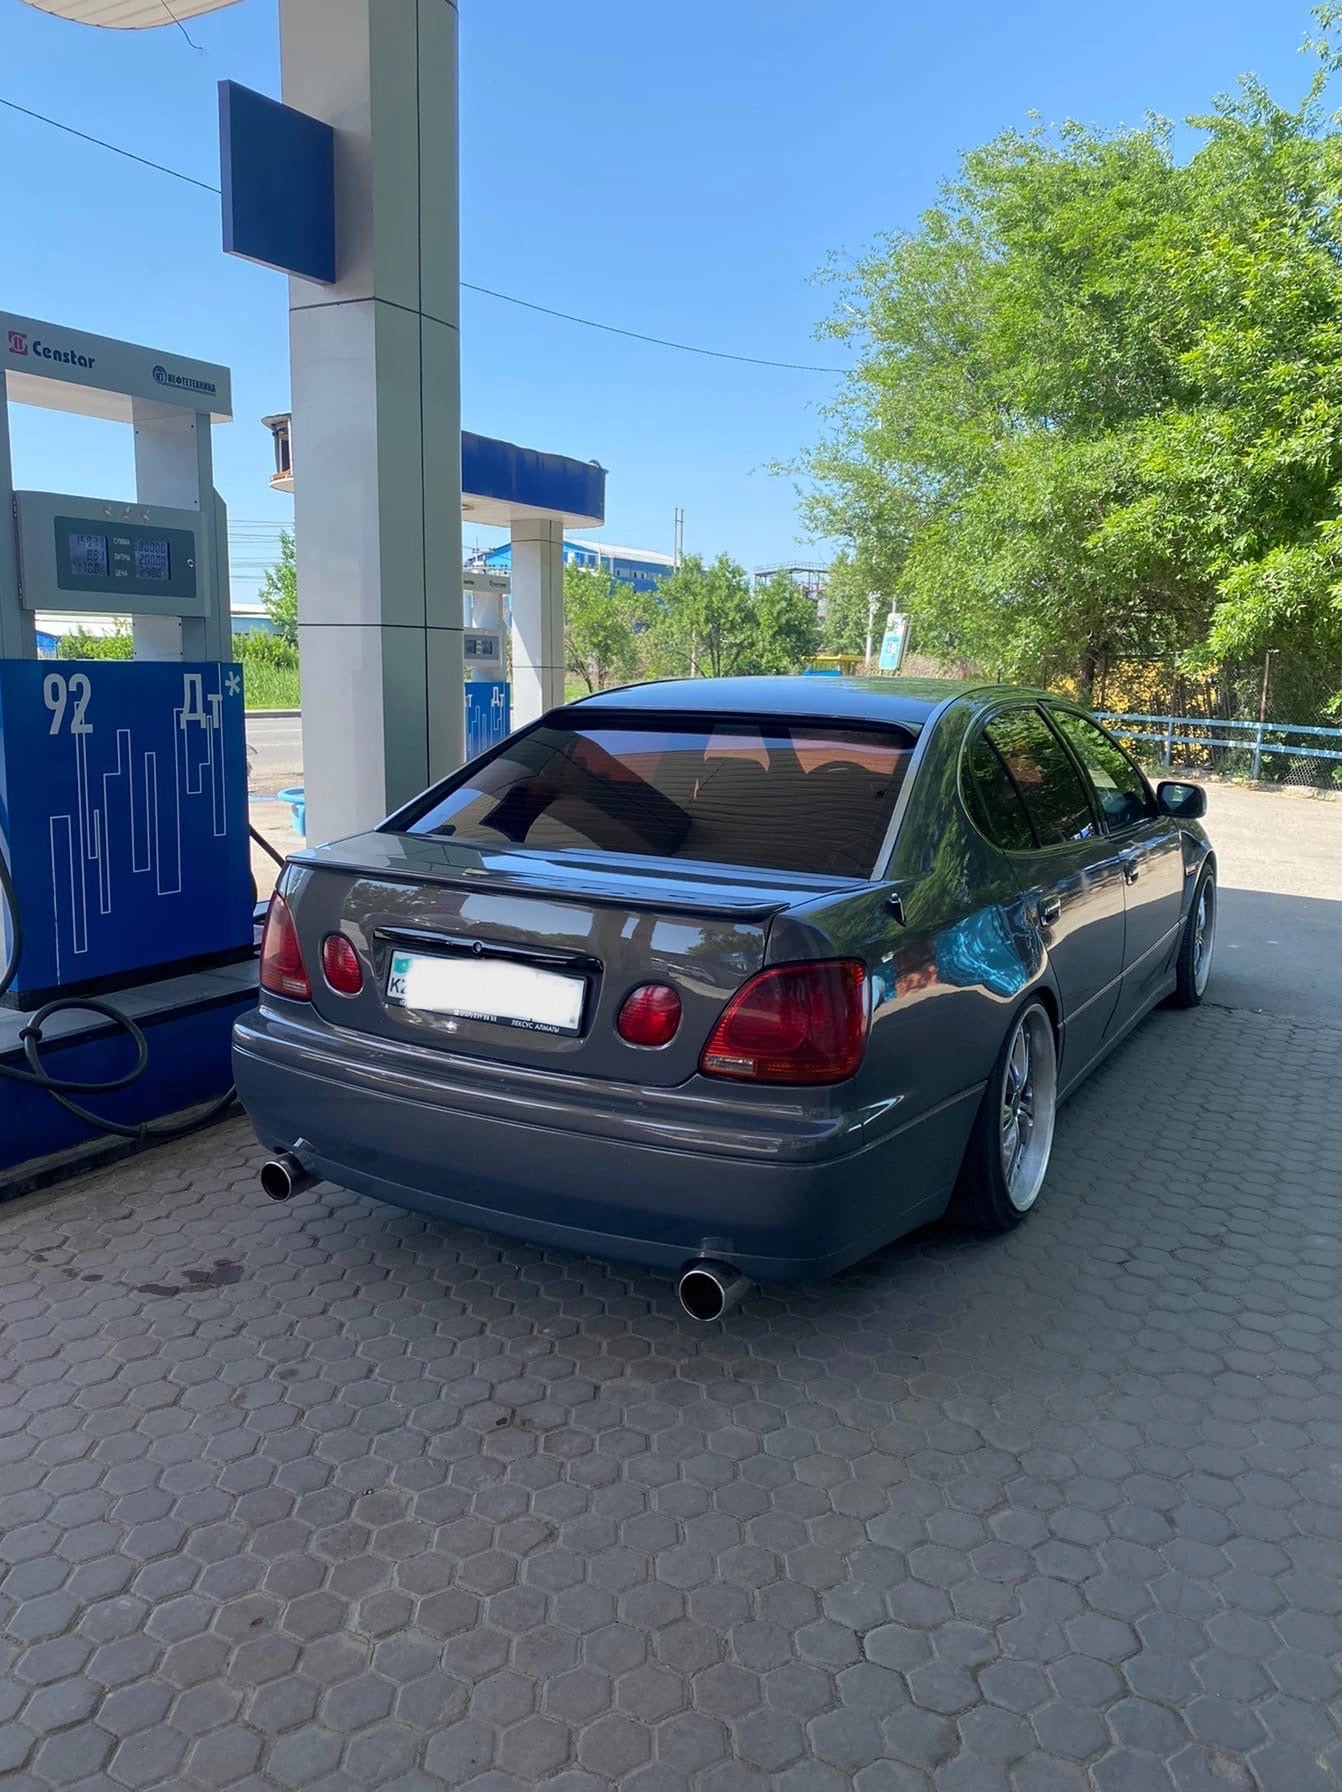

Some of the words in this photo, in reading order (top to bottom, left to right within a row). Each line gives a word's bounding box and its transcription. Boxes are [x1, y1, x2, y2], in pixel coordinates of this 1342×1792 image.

[32, 340, 96, 369] Censtar
[167, 373, 217, 393] НЕФТЕТЕХНИКА
[115, 569, 128, 577] ЦЕНА
[43, 673, 93, 735] 92
[510, 1019, 534, 1029] ЛЕКСУС
[534, 1023, 560, 1033] АЛМАТЫ
